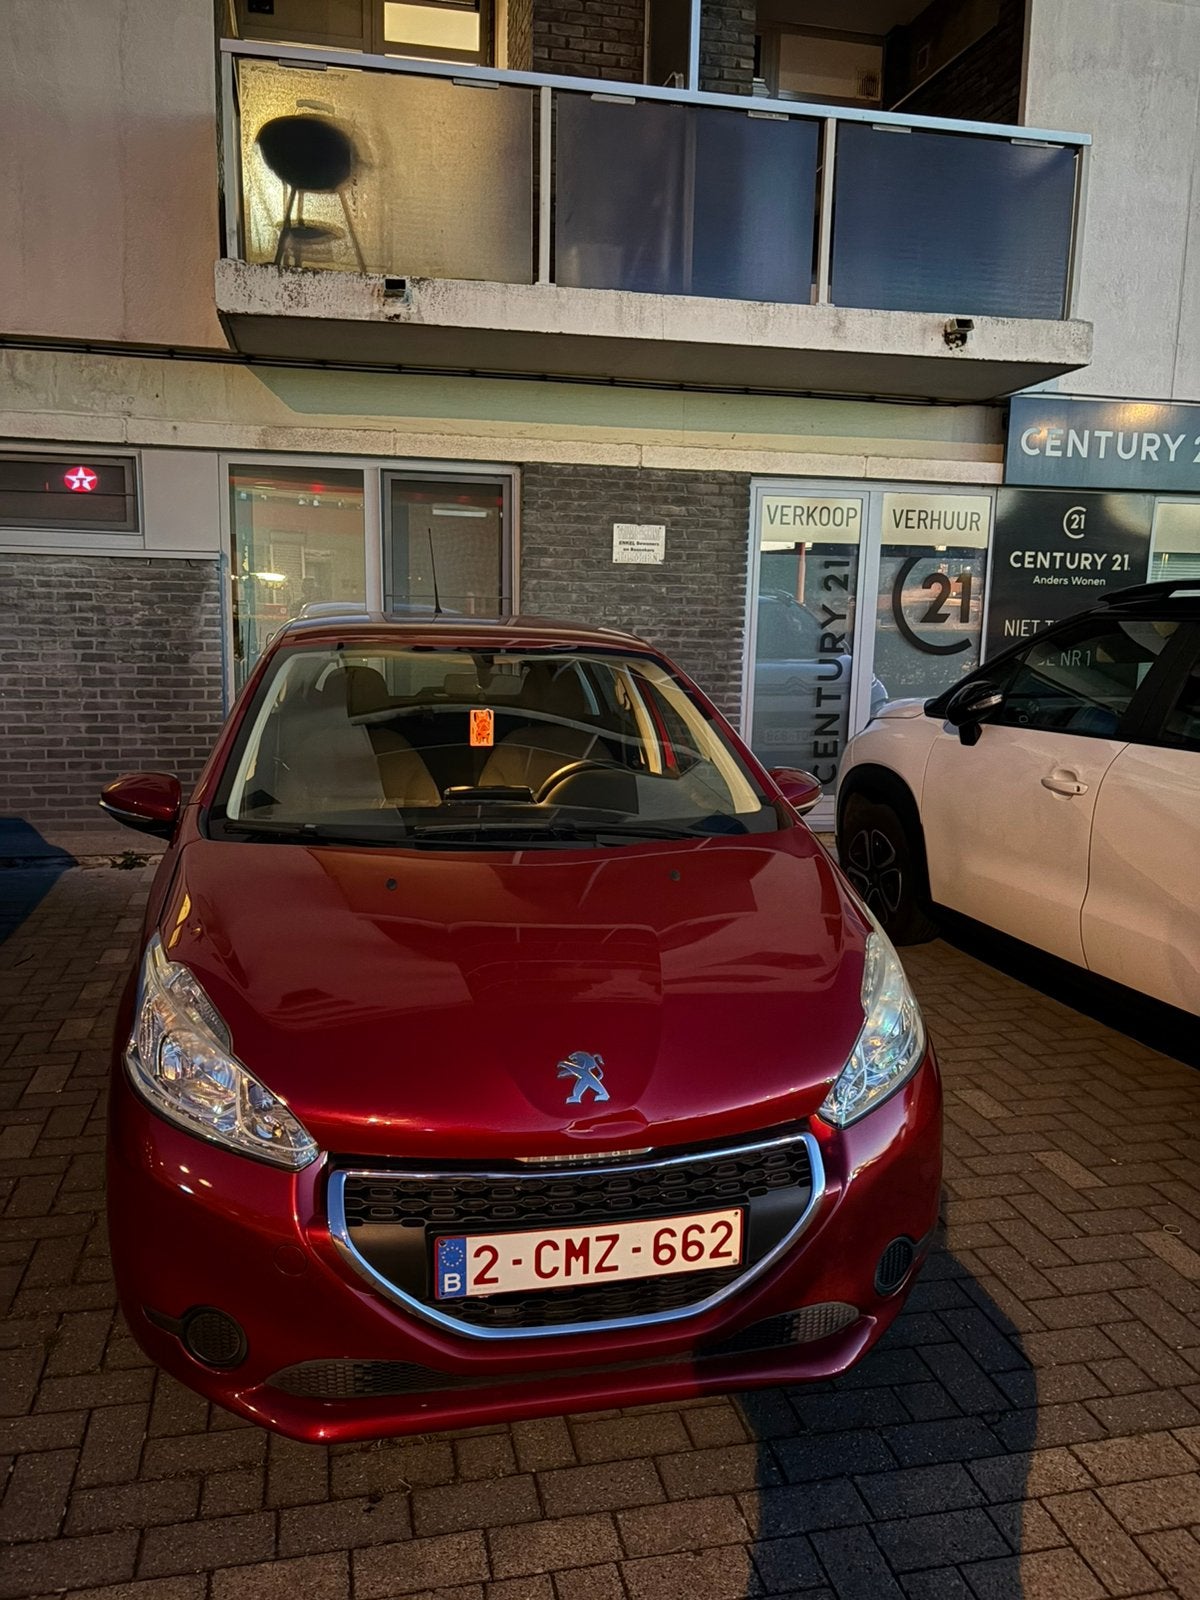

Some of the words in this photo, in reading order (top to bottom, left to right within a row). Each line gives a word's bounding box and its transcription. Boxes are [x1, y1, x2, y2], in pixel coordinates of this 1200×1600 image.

[1021, 427, 1186, 462] CENTURY
[766, 504, 858, 528] VERKOOP
[893, 508, 981, 532] VERHUUR
[1010, 551, 1107, 571] CENTURY
[824, 560, 850, 592] 21
[1033, 575, 1069, 586] Anders
[1070, 576, 1106, 586] Wonen
[1004, 619, 1041, 637] NIET
[1060, 649, 1082, 667] NR
[1086, 650, 1091, 667] 1
[813, 604, 847, 785] CENTURY
[444, 1273, 461, 1293] B
